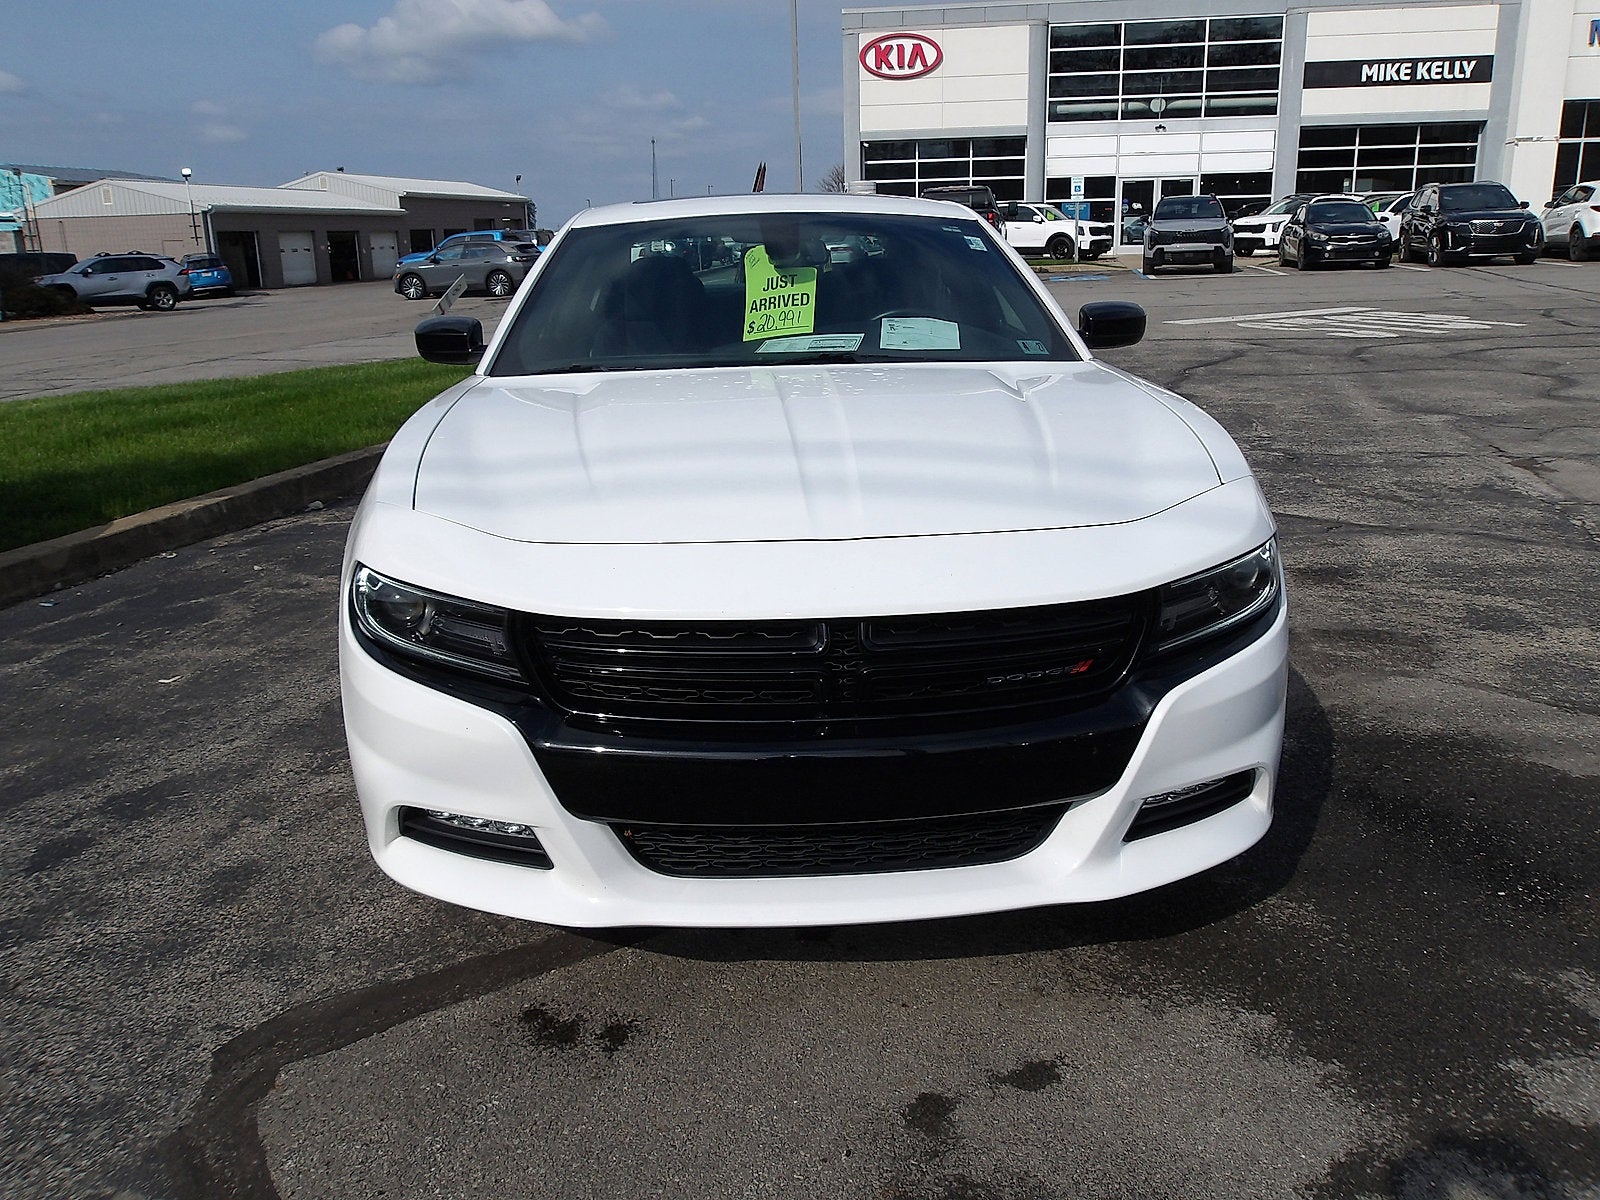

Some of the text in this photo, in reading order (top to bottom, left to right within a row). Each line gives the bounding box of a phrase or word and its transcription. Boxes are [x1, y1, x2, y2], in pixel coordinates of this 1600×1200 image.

[873, 43, 929, 70] KIA
[1361, 60, 1477, 82] MIKE KELLY
[762, 274, 798, 292] JUST
[749, 292, 811, 314] ARRIVED
